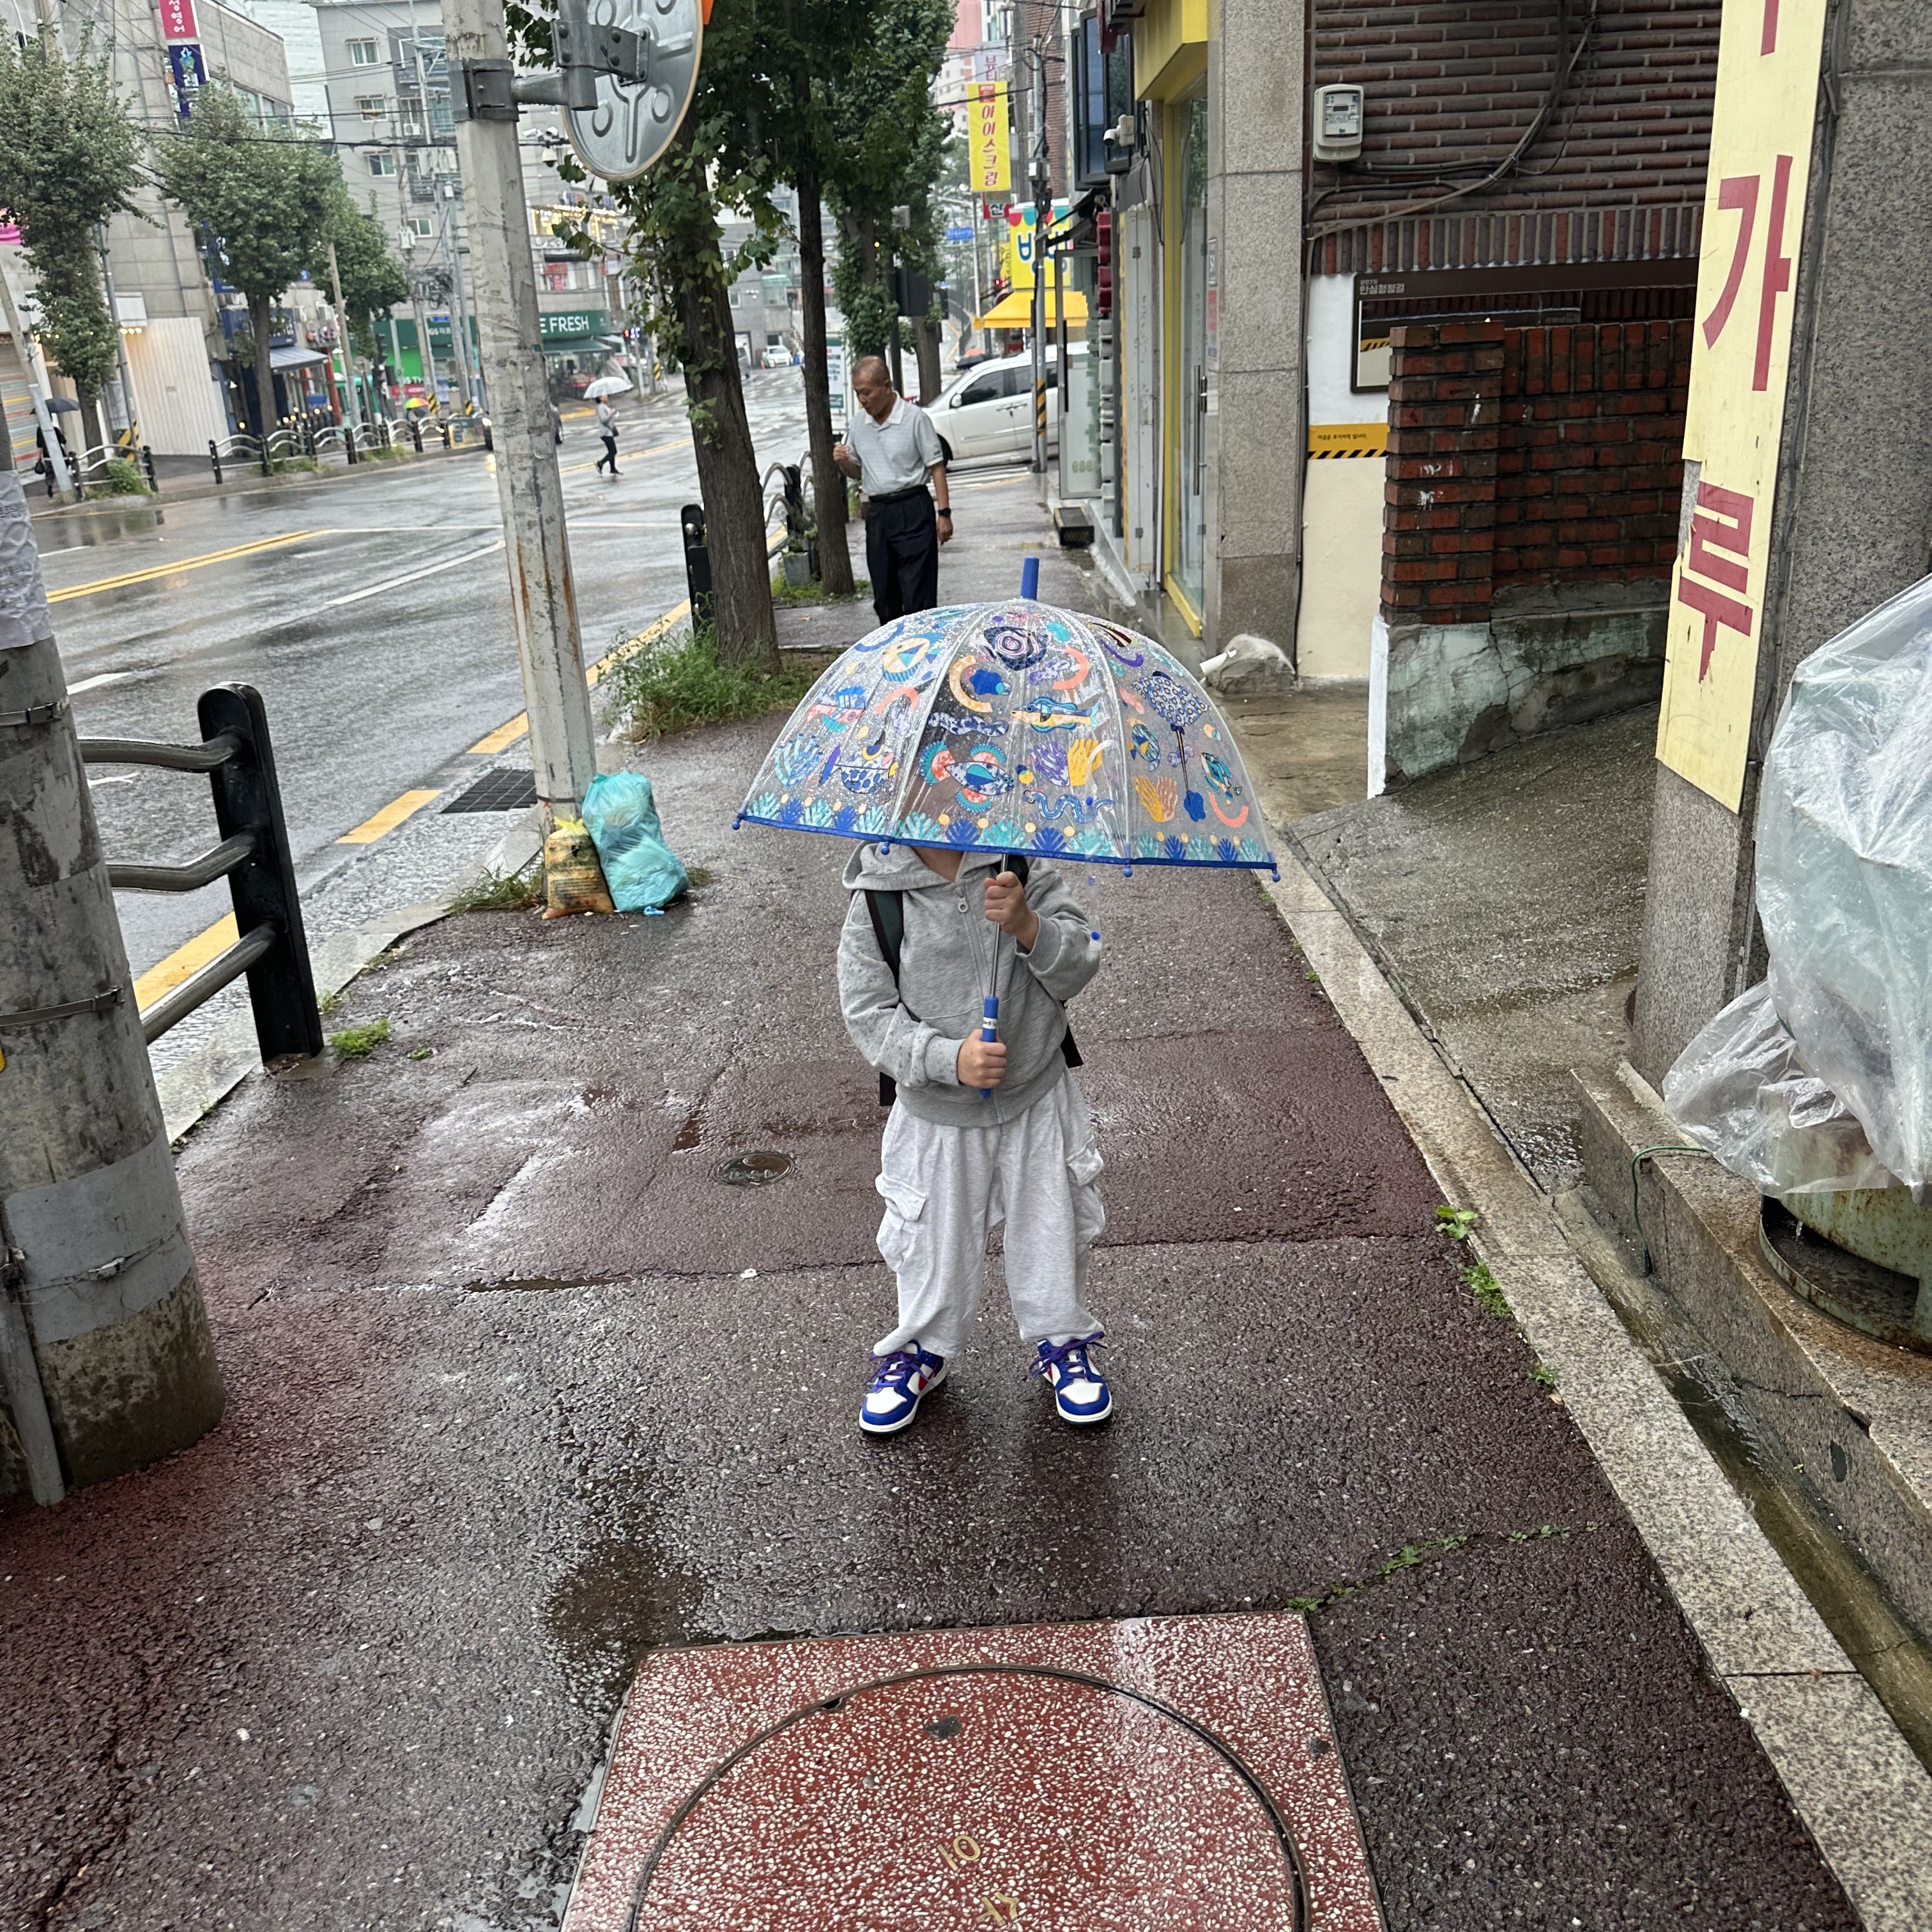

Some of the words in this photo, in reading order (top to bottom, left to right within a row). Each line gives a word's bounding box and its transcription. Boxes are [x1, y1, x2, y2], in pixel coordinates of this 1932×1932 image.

[982, 105, 997, 187] 아이스크림
[549, 315, 589, 333] FRESH
[1677, 0, 1793, 685] 가루
